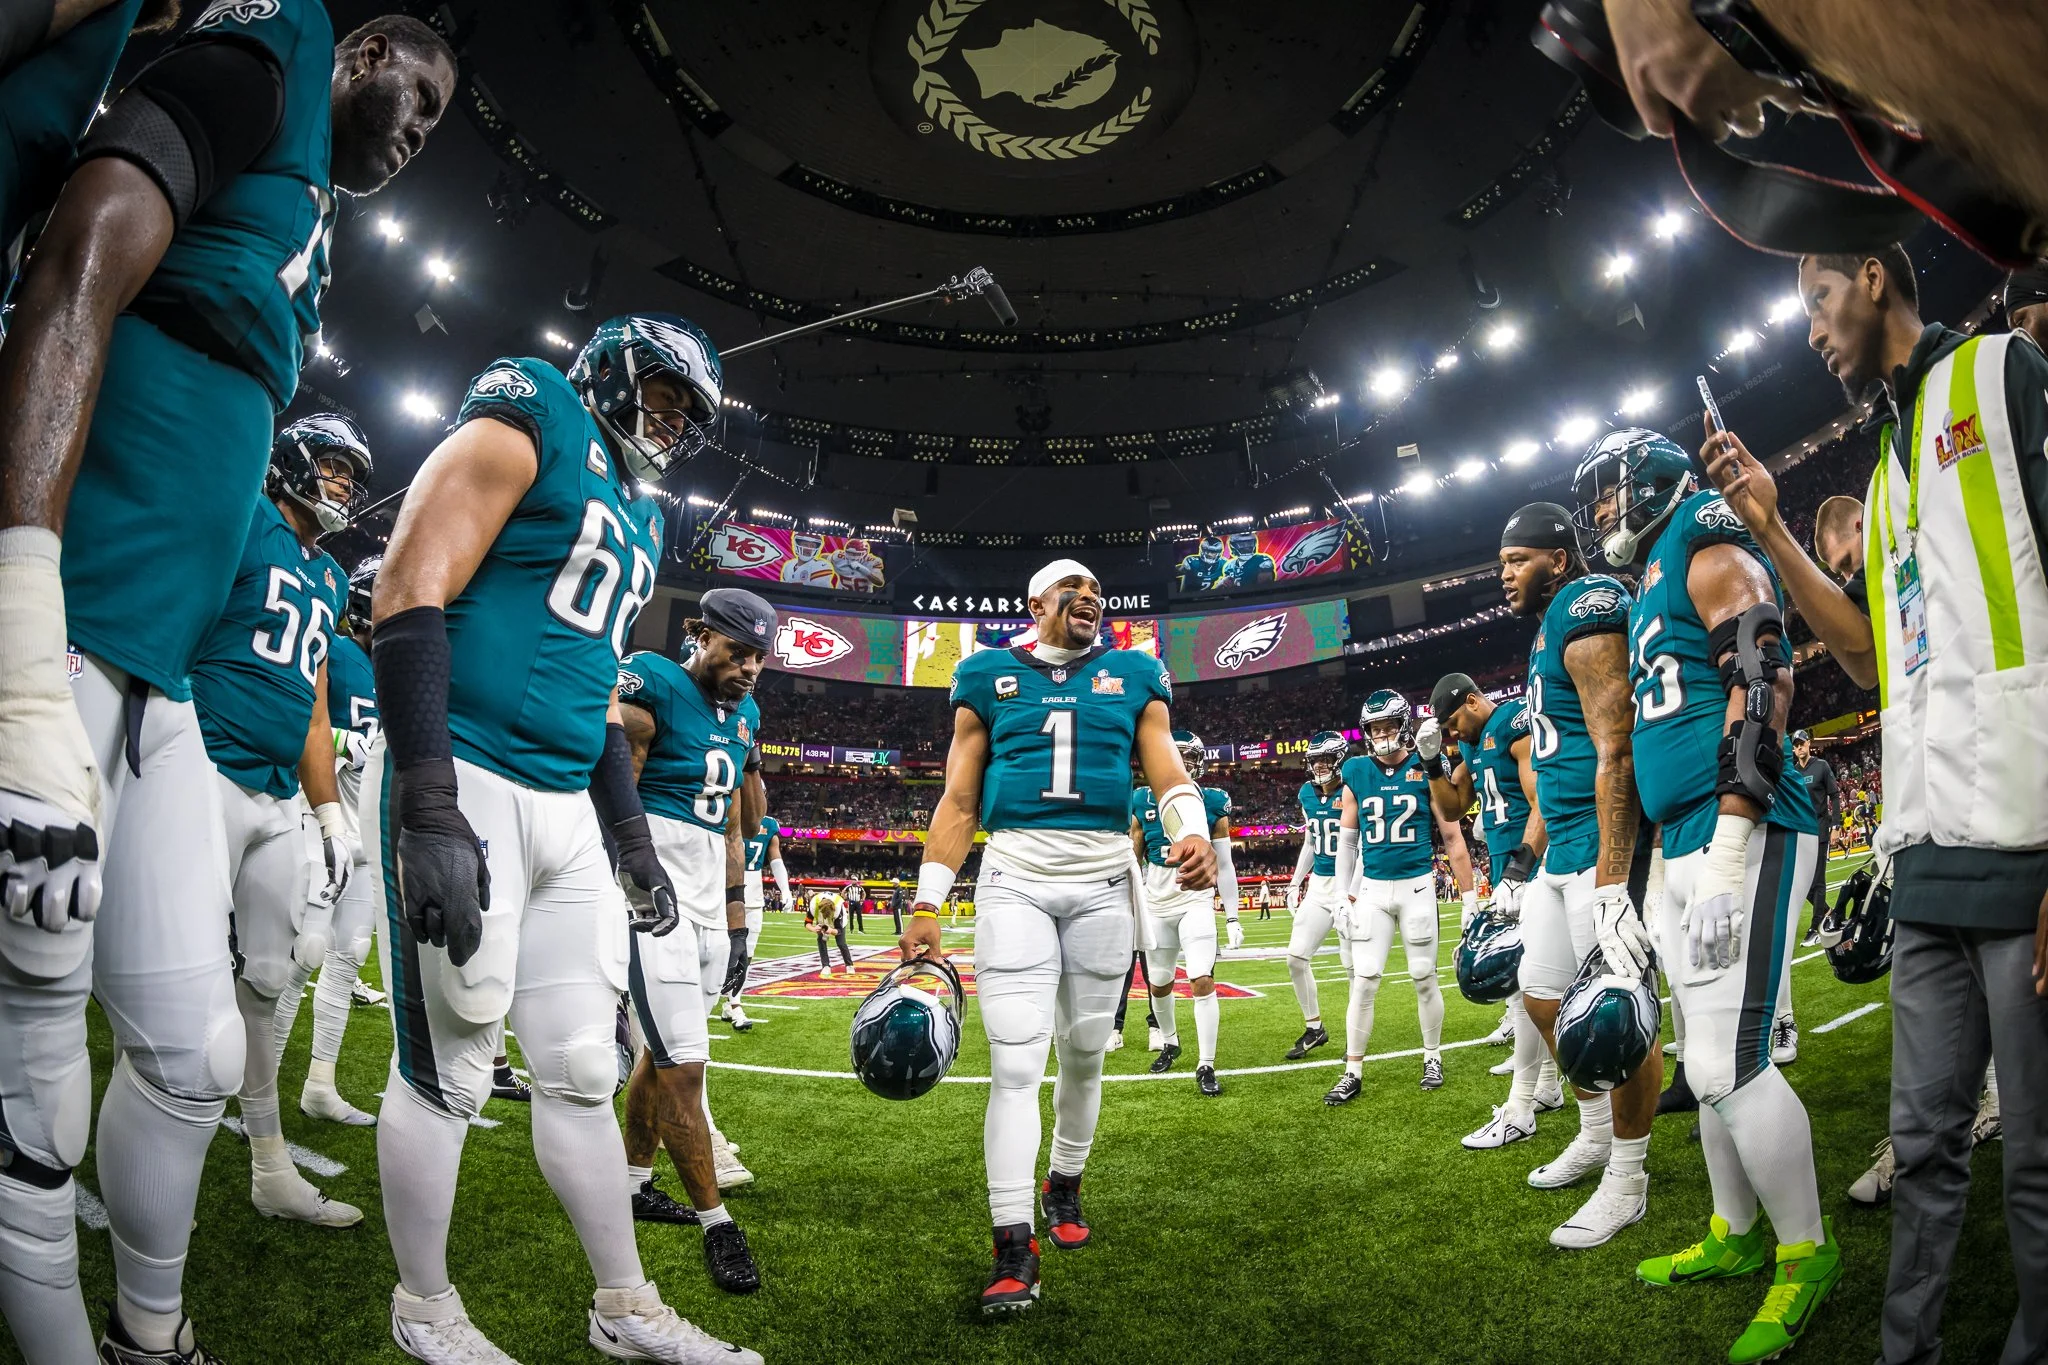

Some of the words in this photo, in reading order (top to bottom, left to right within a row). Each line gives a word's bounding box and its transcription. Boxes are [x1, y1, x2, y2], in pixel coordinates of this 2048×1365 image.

[317, 392, 357, 421] 1993-2001
[1667, 410, 1701, 435] MORTEN
[1941, 455, 1961, 471] SUPER
[1962, 445, 1983, 459] BOWL
[545, 498, 656, 660] 68
[912, 594, 1023, 613] CAESARS
[249, 563, 336, 688] 56
[792, 629, 834, 658] KC
[1630, 613, 1687, 723] 5
[994, 675, 1018, 696] C
[1041, 696, 1078, 704] EAGLES
[1507, 684, 1522, 696] LIX
[1526, 672, 1561, 762] 8
[709, 733, 730, 745] EAGLES
[1276, 739, 1309, 755] 61:42
[819, 750, 830, 758] PM
[1037, 708, 1085, 802] 1
[692, 747, 737, 828] 8
[1361, 793, 1418, 844] 32
[1308, 818, 1341, 857] 36
[742, 841, 763, 871] 7
